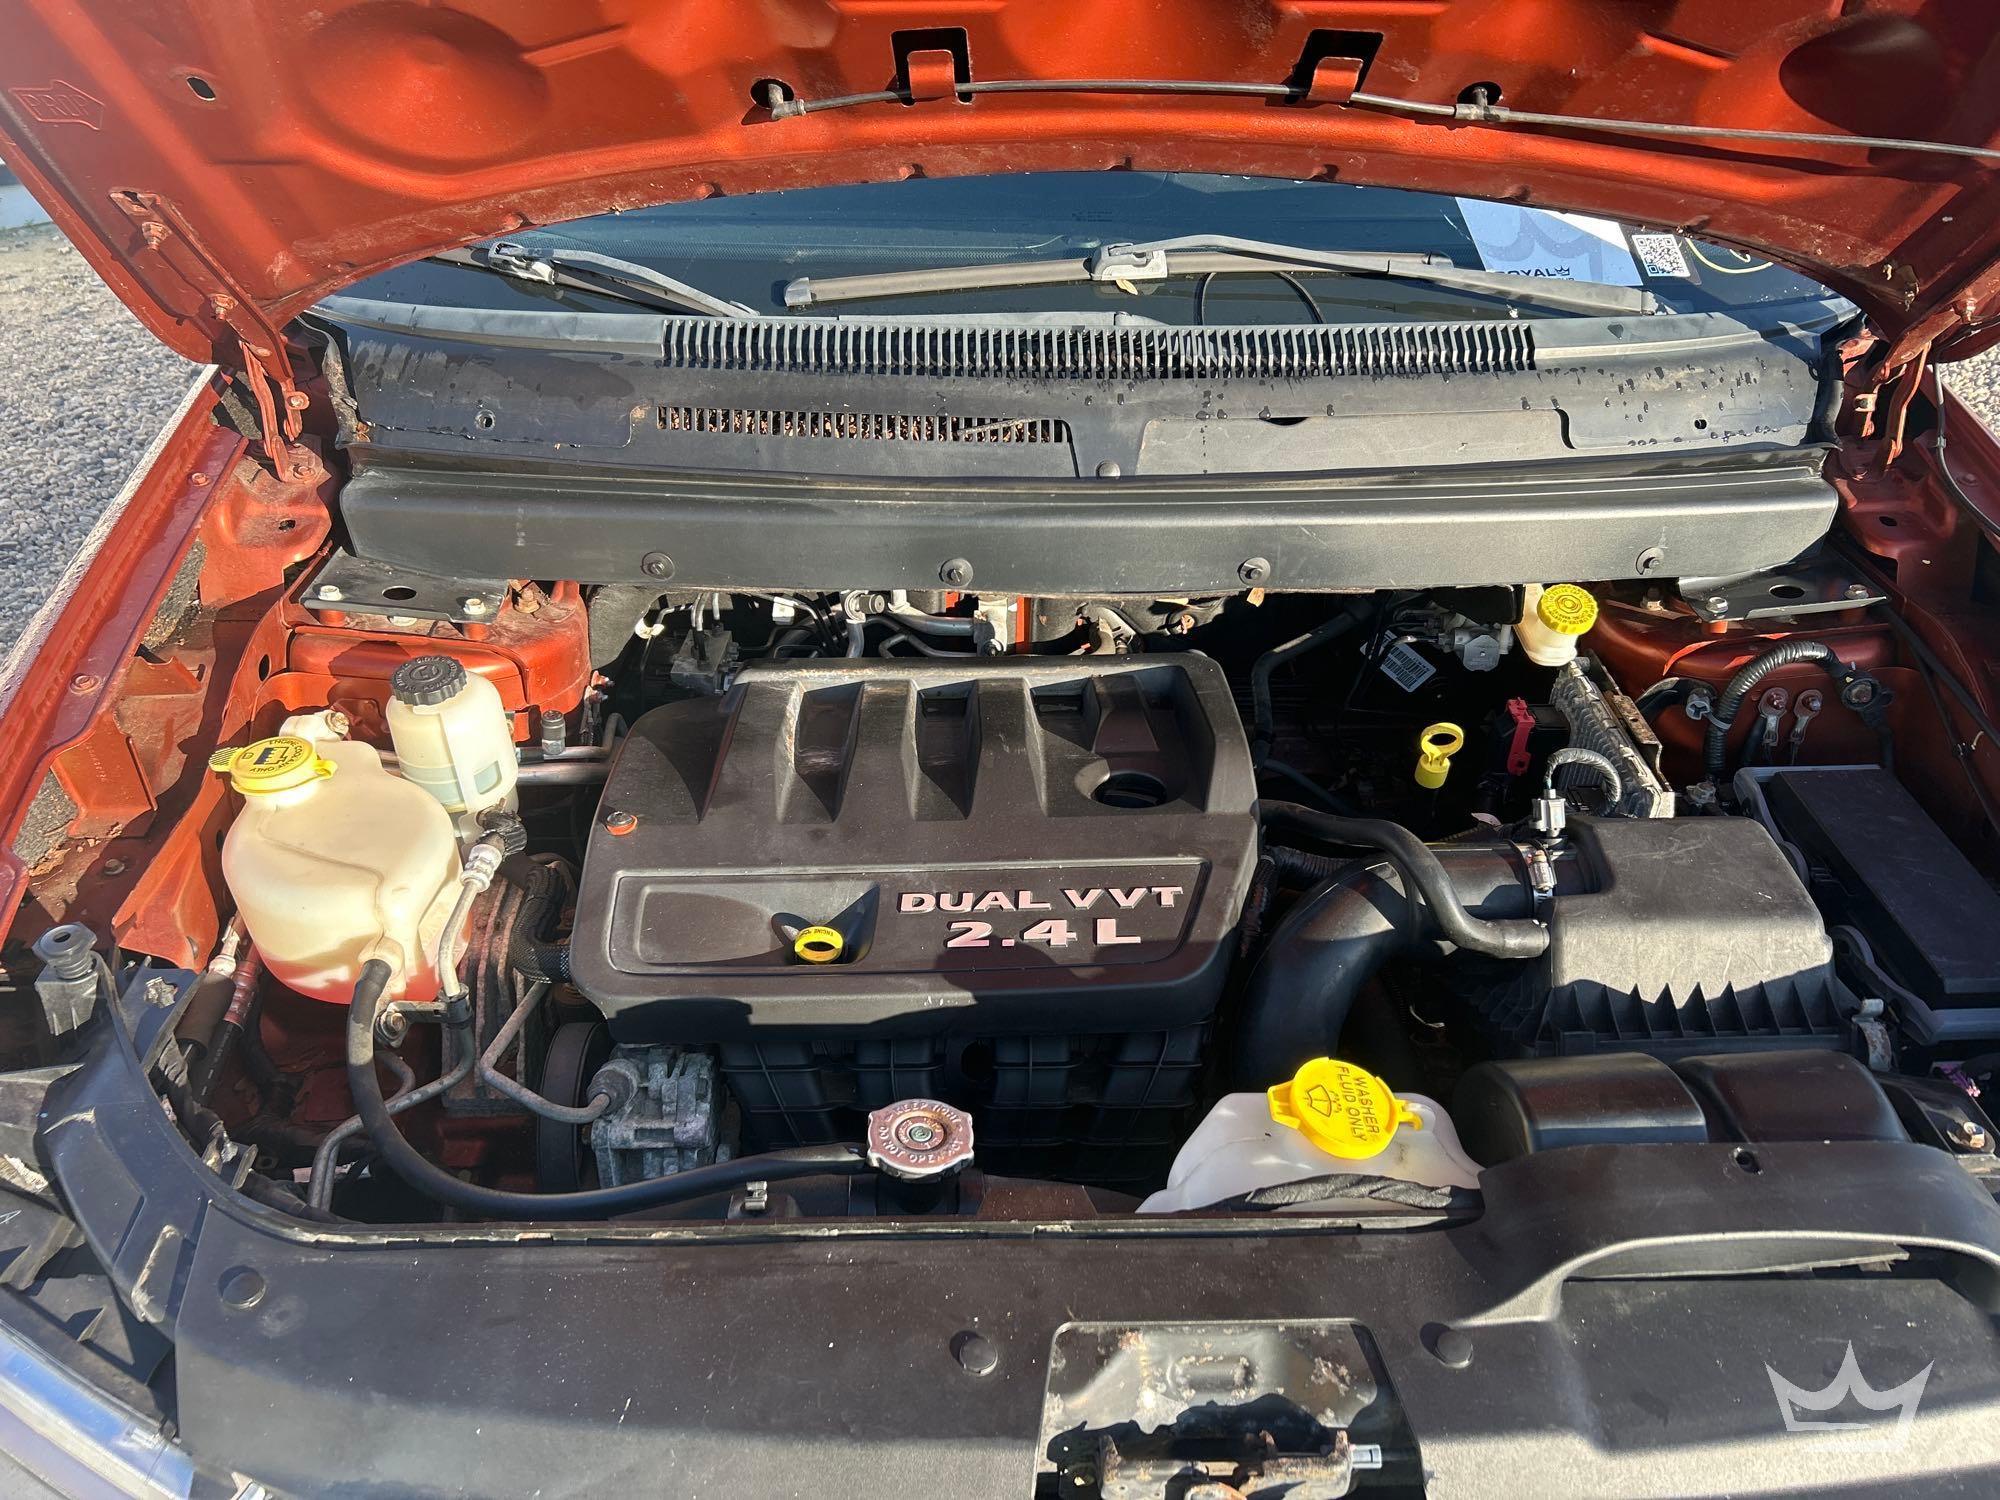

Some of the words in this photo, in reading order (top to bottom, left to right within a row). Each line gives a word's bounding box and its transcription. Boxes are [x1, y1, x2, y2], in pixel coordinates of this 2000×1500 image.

[21, 93, 89, 117] PROP
[268, 739, 298, 748] ENGINE
[898, 890, 1051, 914] DUAL
[1060, 886, 1184, 910] VVT
[893, 1101, 929, 1115] KEEP
[1335, 1065, 1357, 1102] FLUID
[1346, 1106, 1368, 1142] ONLY
[1354, 1076, 1381, 1134] WASHER
[879, 1126, 890, 1140] DO
[883, 1142, 905, 1158] NOT
[909, 1154, 944, 1164] OPEN
